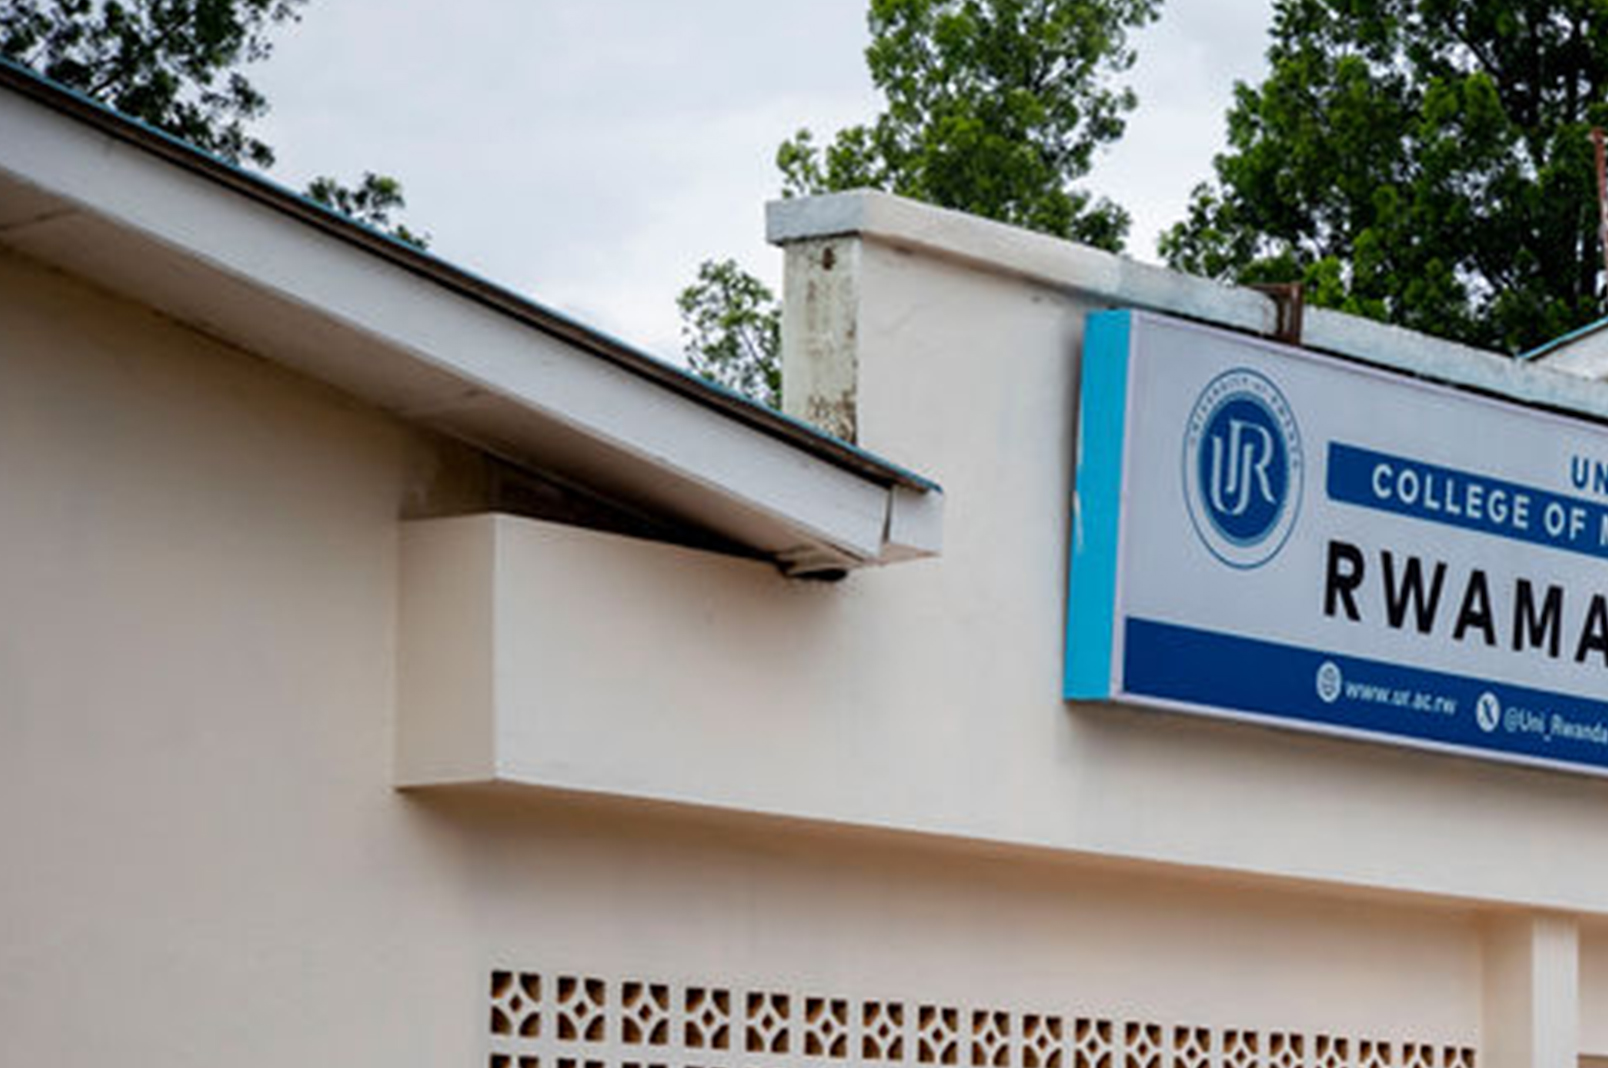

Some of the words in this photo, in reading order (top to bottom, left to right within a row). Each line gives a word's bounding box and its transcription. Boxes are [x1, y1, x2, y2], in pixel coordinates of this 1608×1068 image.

[1371, 463, 1530, 529] COLLEGE
[1543, 502, 1588, 540] OF
[1345, 680, 1457, 715] www.ur.ac.rw
